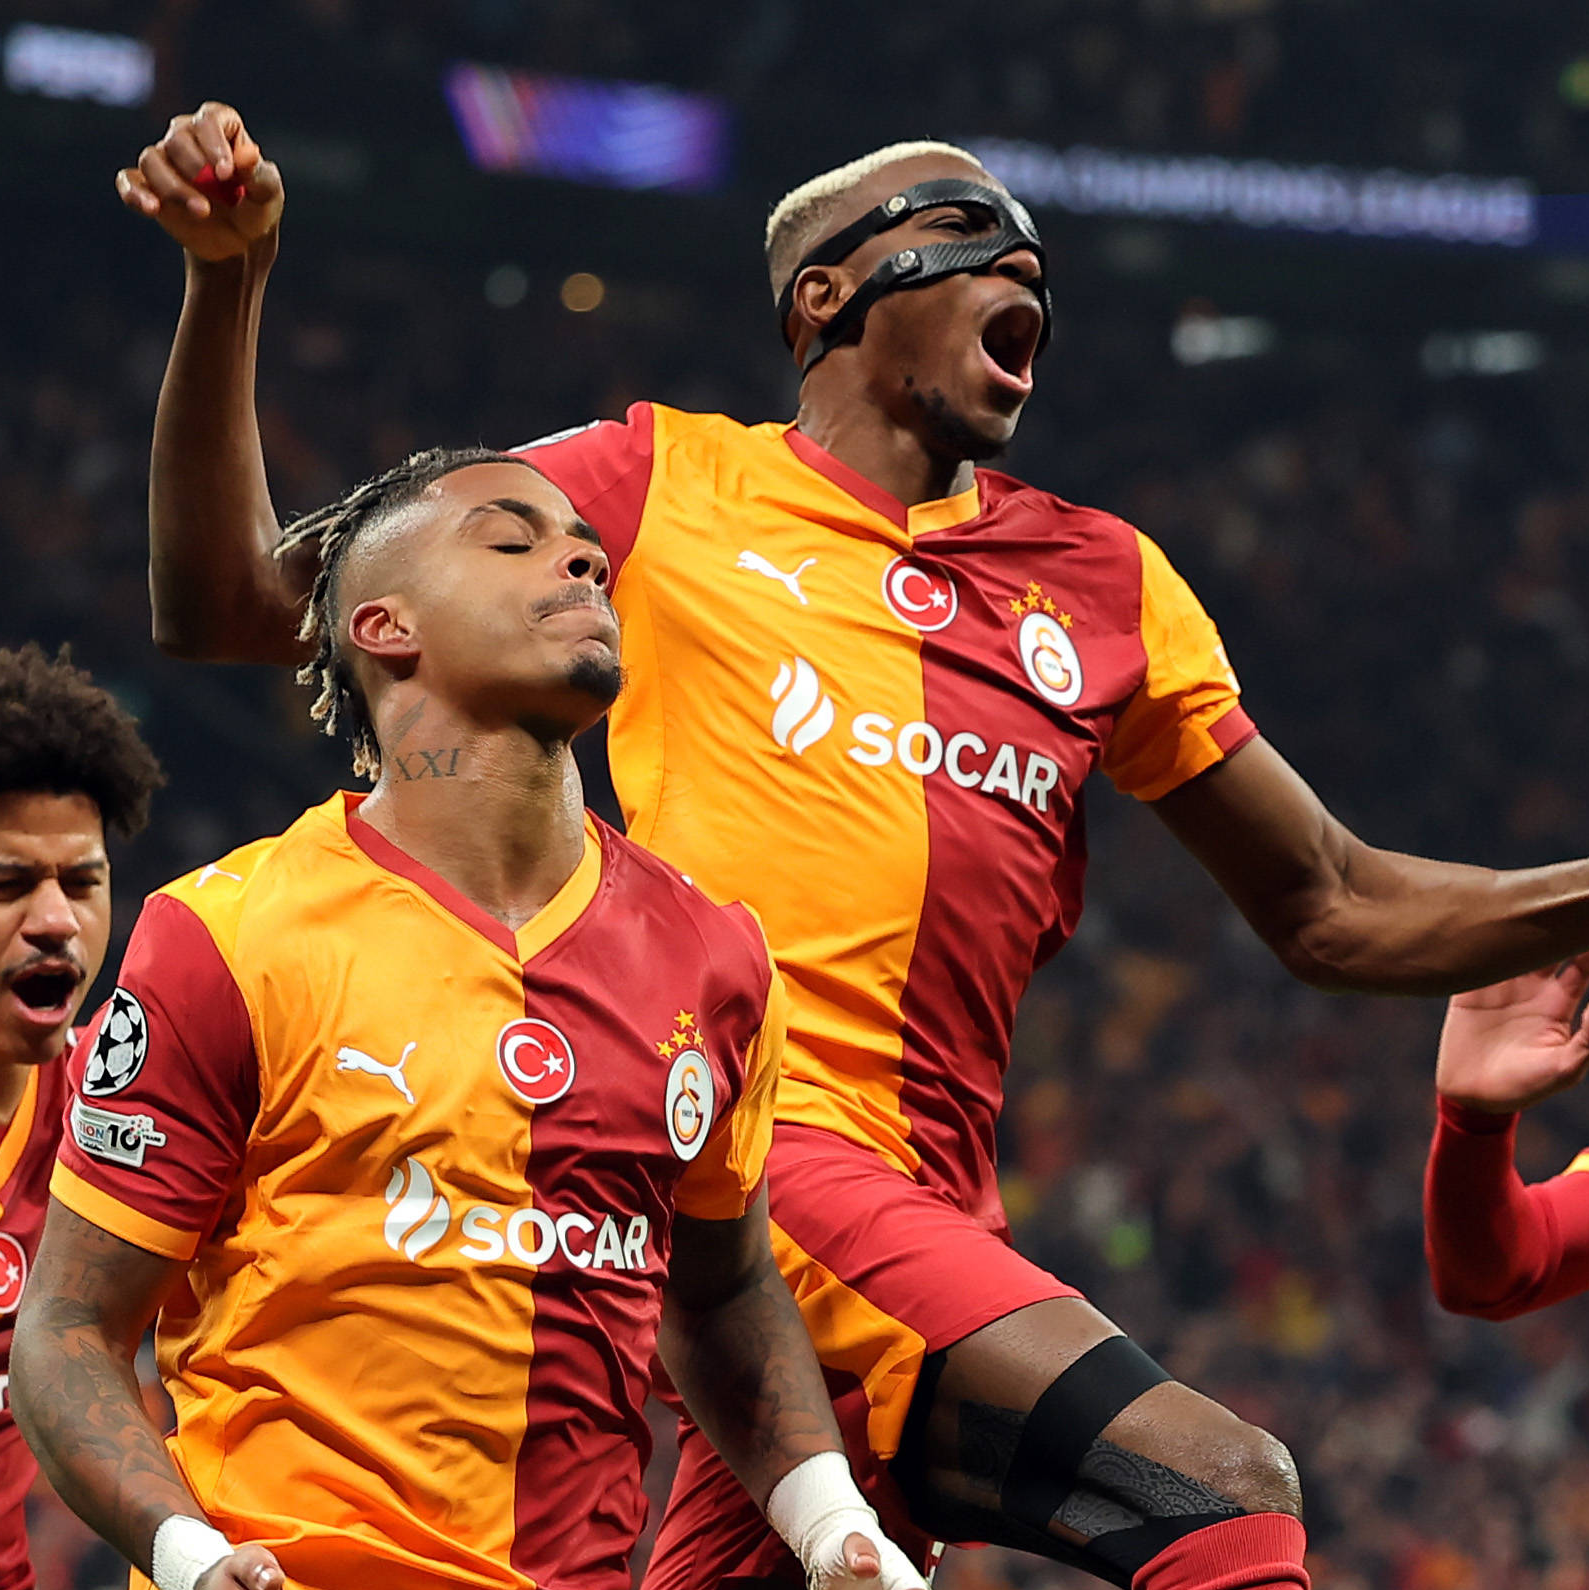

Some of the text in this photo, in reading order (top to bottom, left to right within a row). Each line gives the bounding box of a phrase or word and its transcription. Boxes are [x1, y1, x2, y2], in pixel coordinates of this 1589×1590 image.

[847, 712, 1060, 813] SOCAR
[107, 1123, 142, 1152] 10
[458, 1206, 650, 1270] SOCAR
